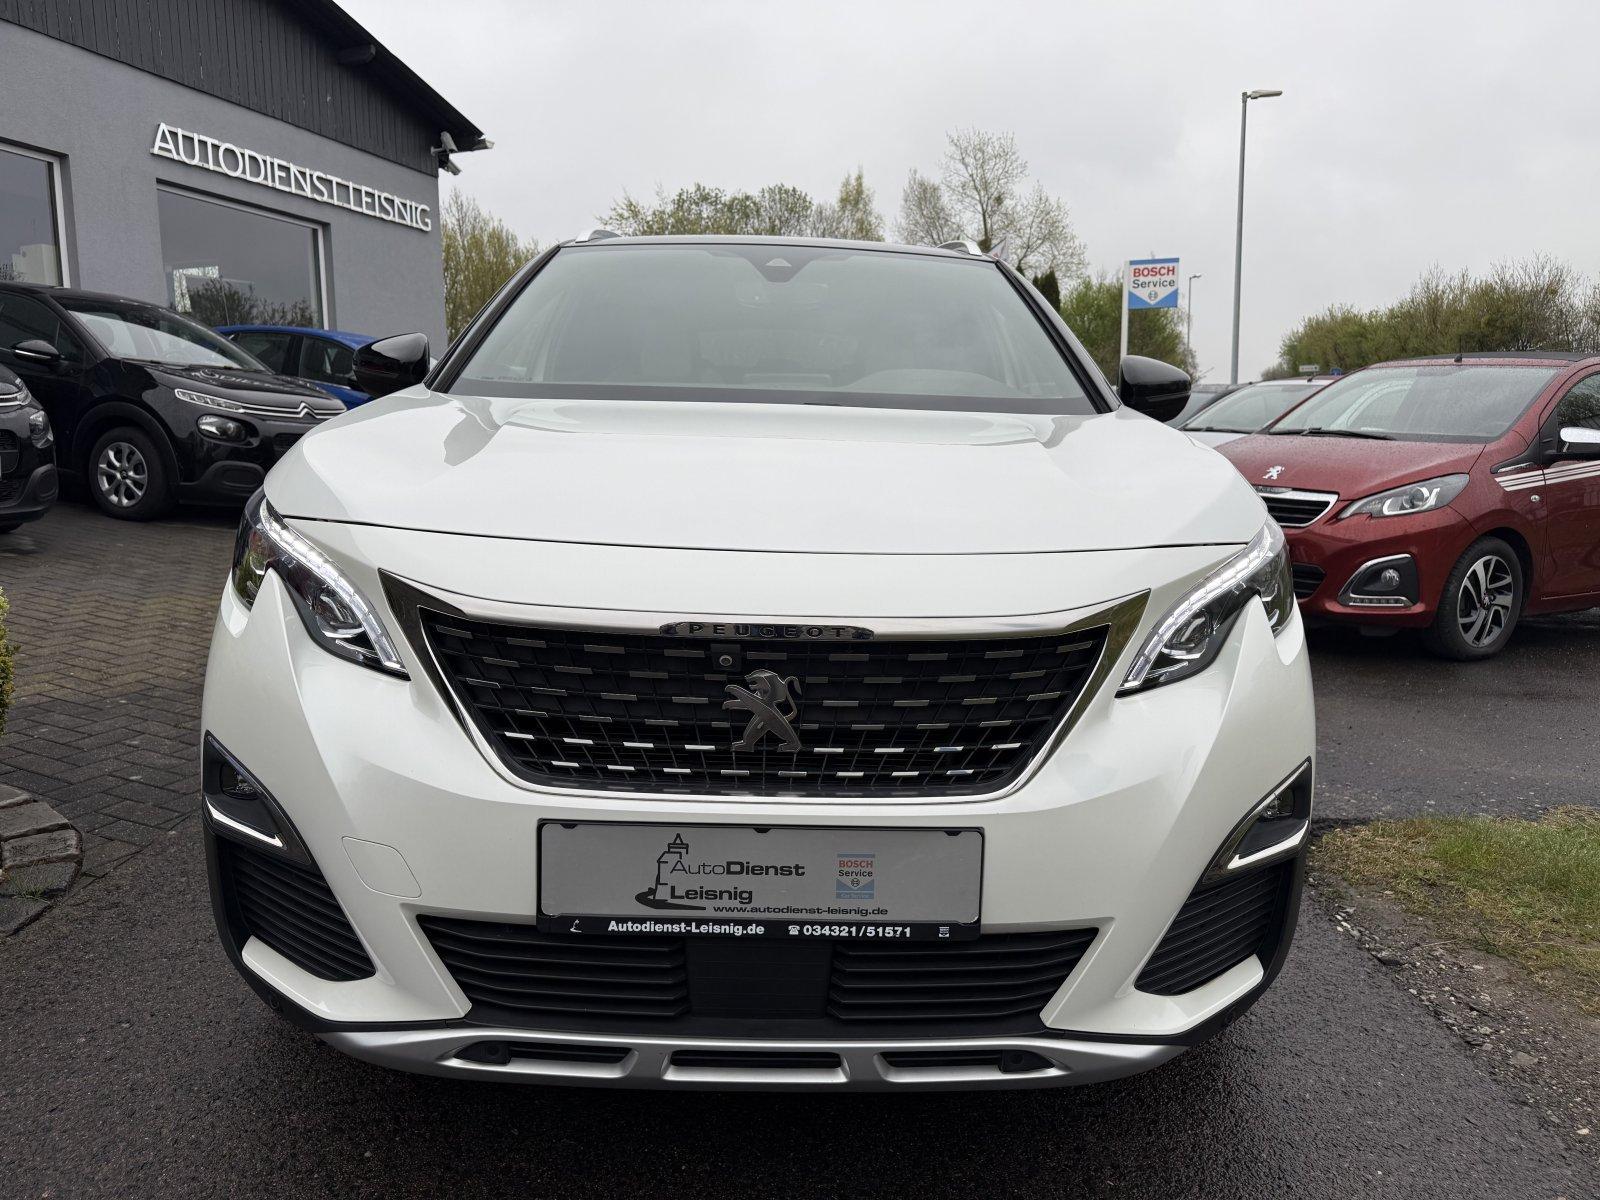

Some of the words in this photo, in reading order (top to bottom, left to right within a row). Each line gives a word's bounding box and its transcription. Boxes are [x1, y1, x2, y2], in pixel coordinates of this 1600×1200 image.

[153, 122, 345, 205] AUTODIENST
[349, 181, 432, 232] LEISNIG
[1133, 265, 1175, 278] BOSCH
[1132, 279, 1175, 289] Service
[689, 624, 845, 639] PEUGEOT
[670, 860, 806, 876] AutoDienst
[838, 860, 873, 868] BOSCH
[838, 869, 873, 877] Service
[670, 885, 753, 904] Leisnig
[713, 904, 889, 916] www.autodienst-leisnig.de
[607, 920, 765, 935] Autodienst-Leisnig.de
[803, 925, 911, 938] 034321/51571
